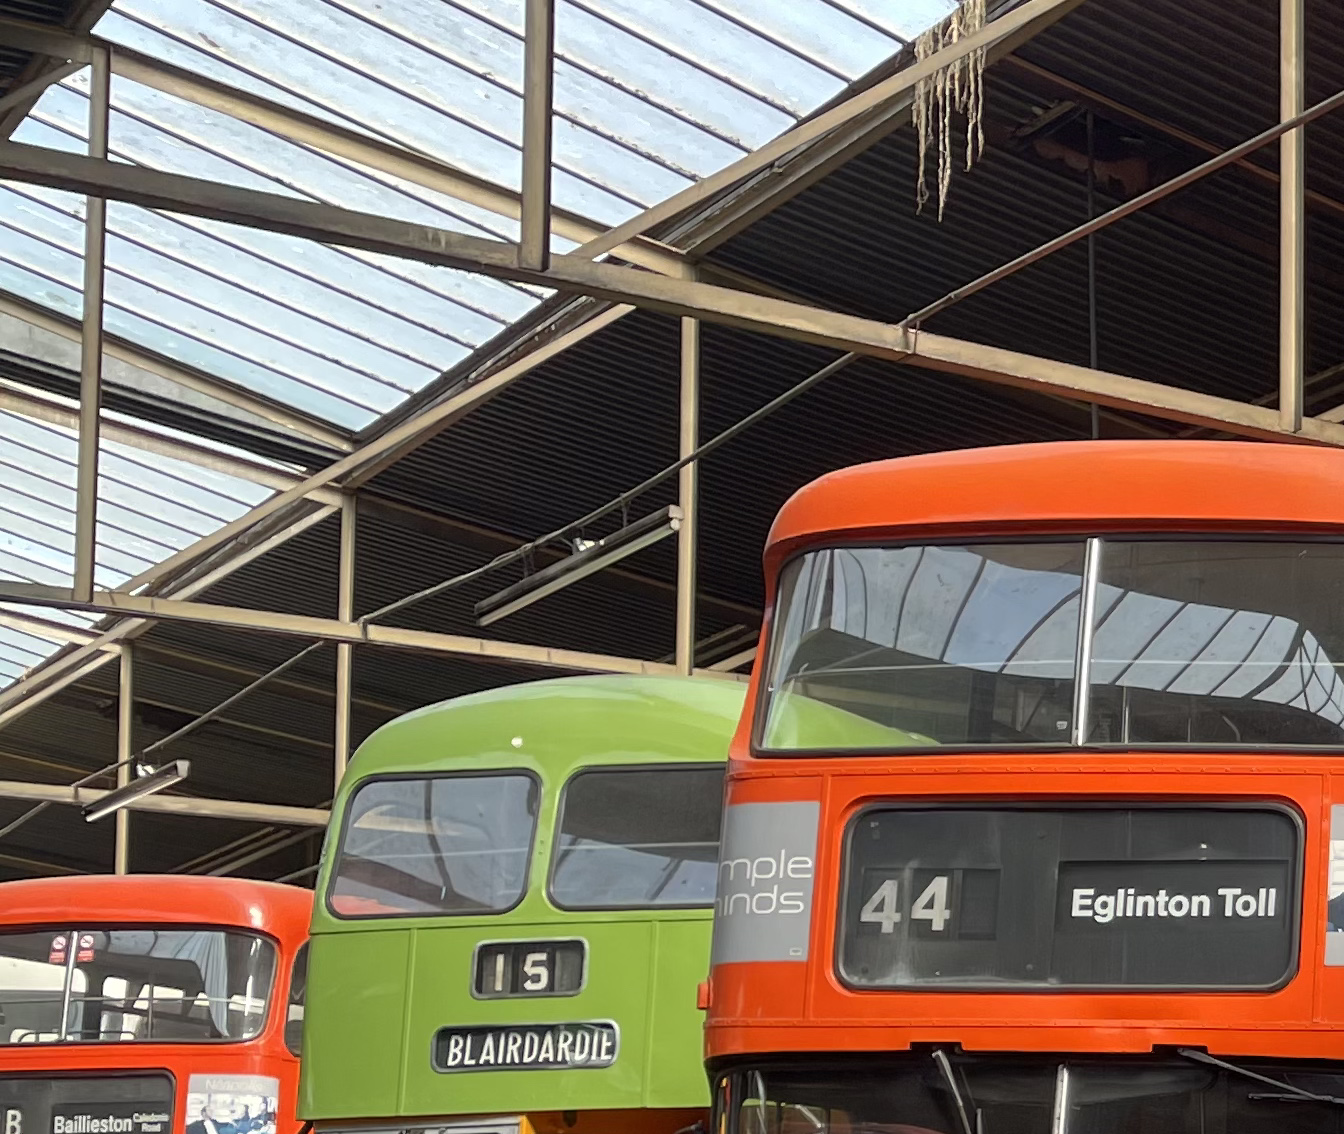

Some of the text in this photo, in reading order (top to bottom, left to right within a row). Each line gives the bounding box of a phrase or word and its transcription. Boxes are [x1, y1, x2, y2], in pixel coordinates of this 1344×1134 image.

[859, 875, 951, 934] 44
[1071, 887, 1277, 923] Eglinton Toll
[494, 952, 549, 991] 15
[446, 1029, 614, 1067] BLAIRDARDIE
[53, 1114, 132, 1134] Baillieston
